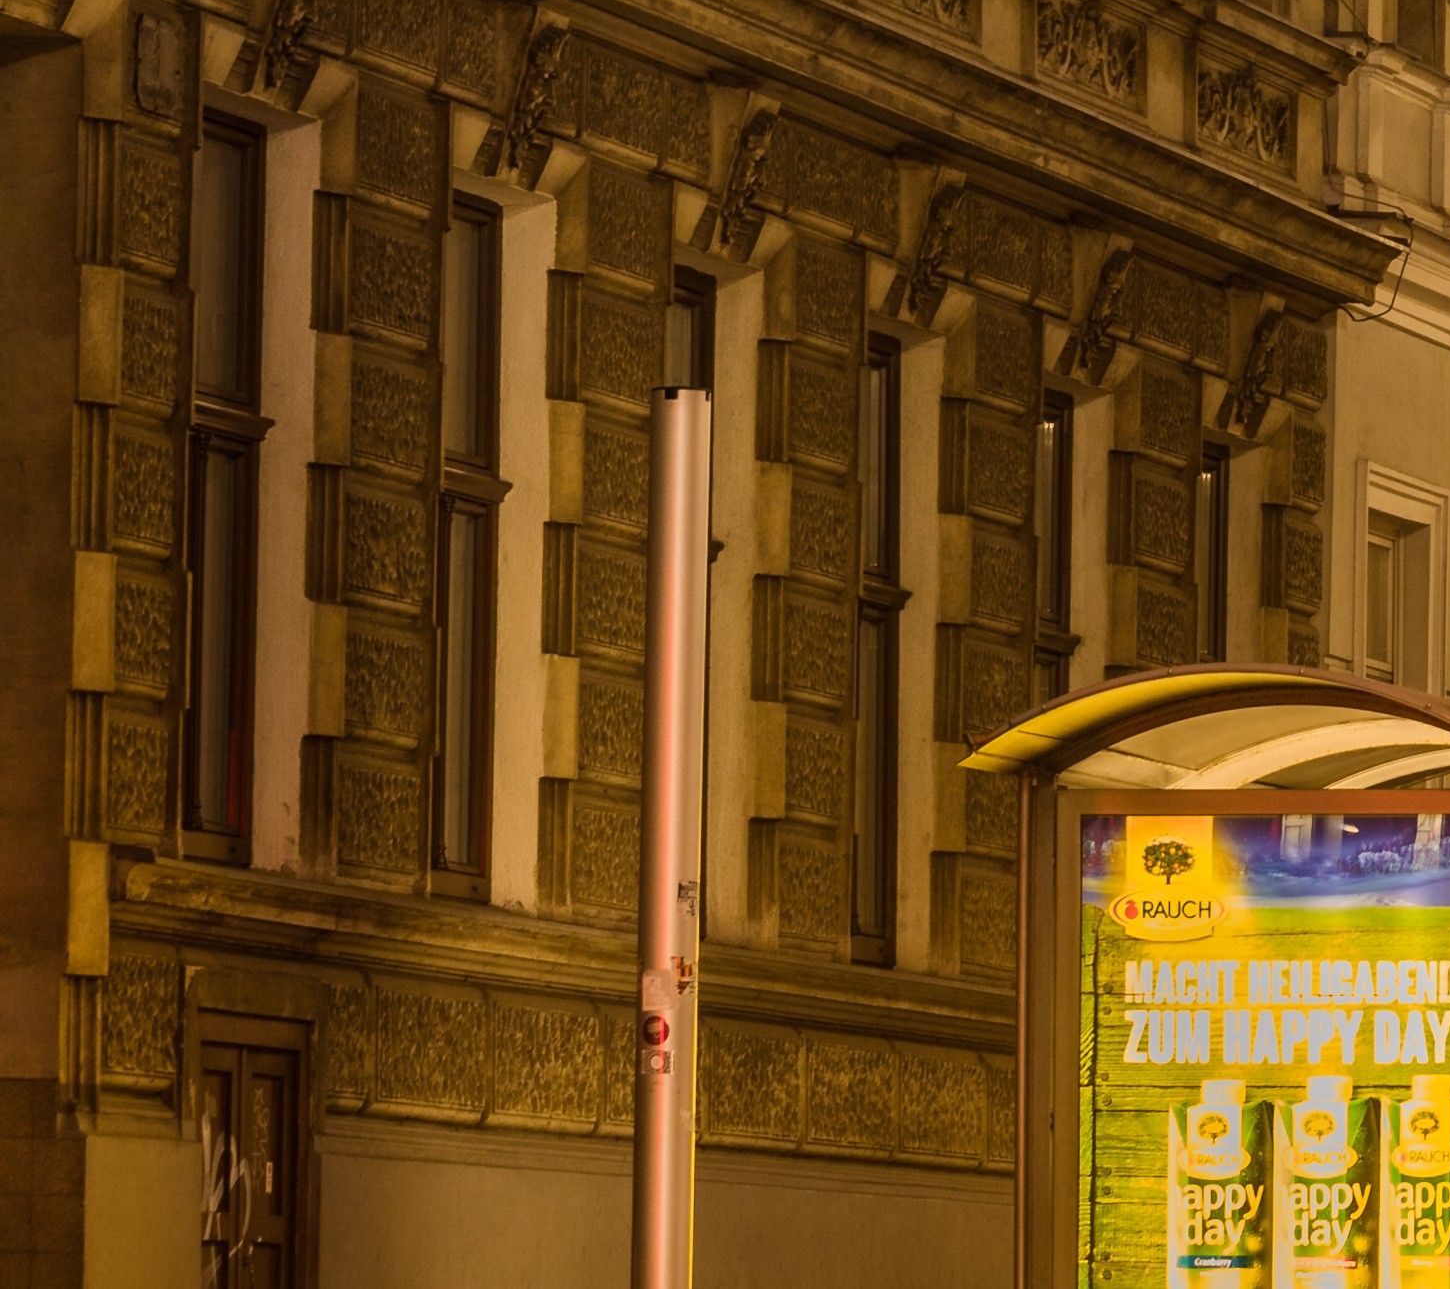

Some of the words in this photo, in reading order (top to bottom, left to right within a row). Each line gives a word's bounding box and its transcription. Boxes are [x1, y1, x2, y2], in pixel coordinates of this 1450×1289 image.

[1141, 899, 1212, 920] RAUCH
[1124, 959, 1240, 1005] MACHT
[1122, 1009, 1211, 1065] ZUM
[1222, 1009, 1364, 1065] HAPPY
[1409, 1149, 1450, 1164] RAUCH
[1184, 1211, 1247, 1256] day
[1289, 1211, 1353, 1256] day
